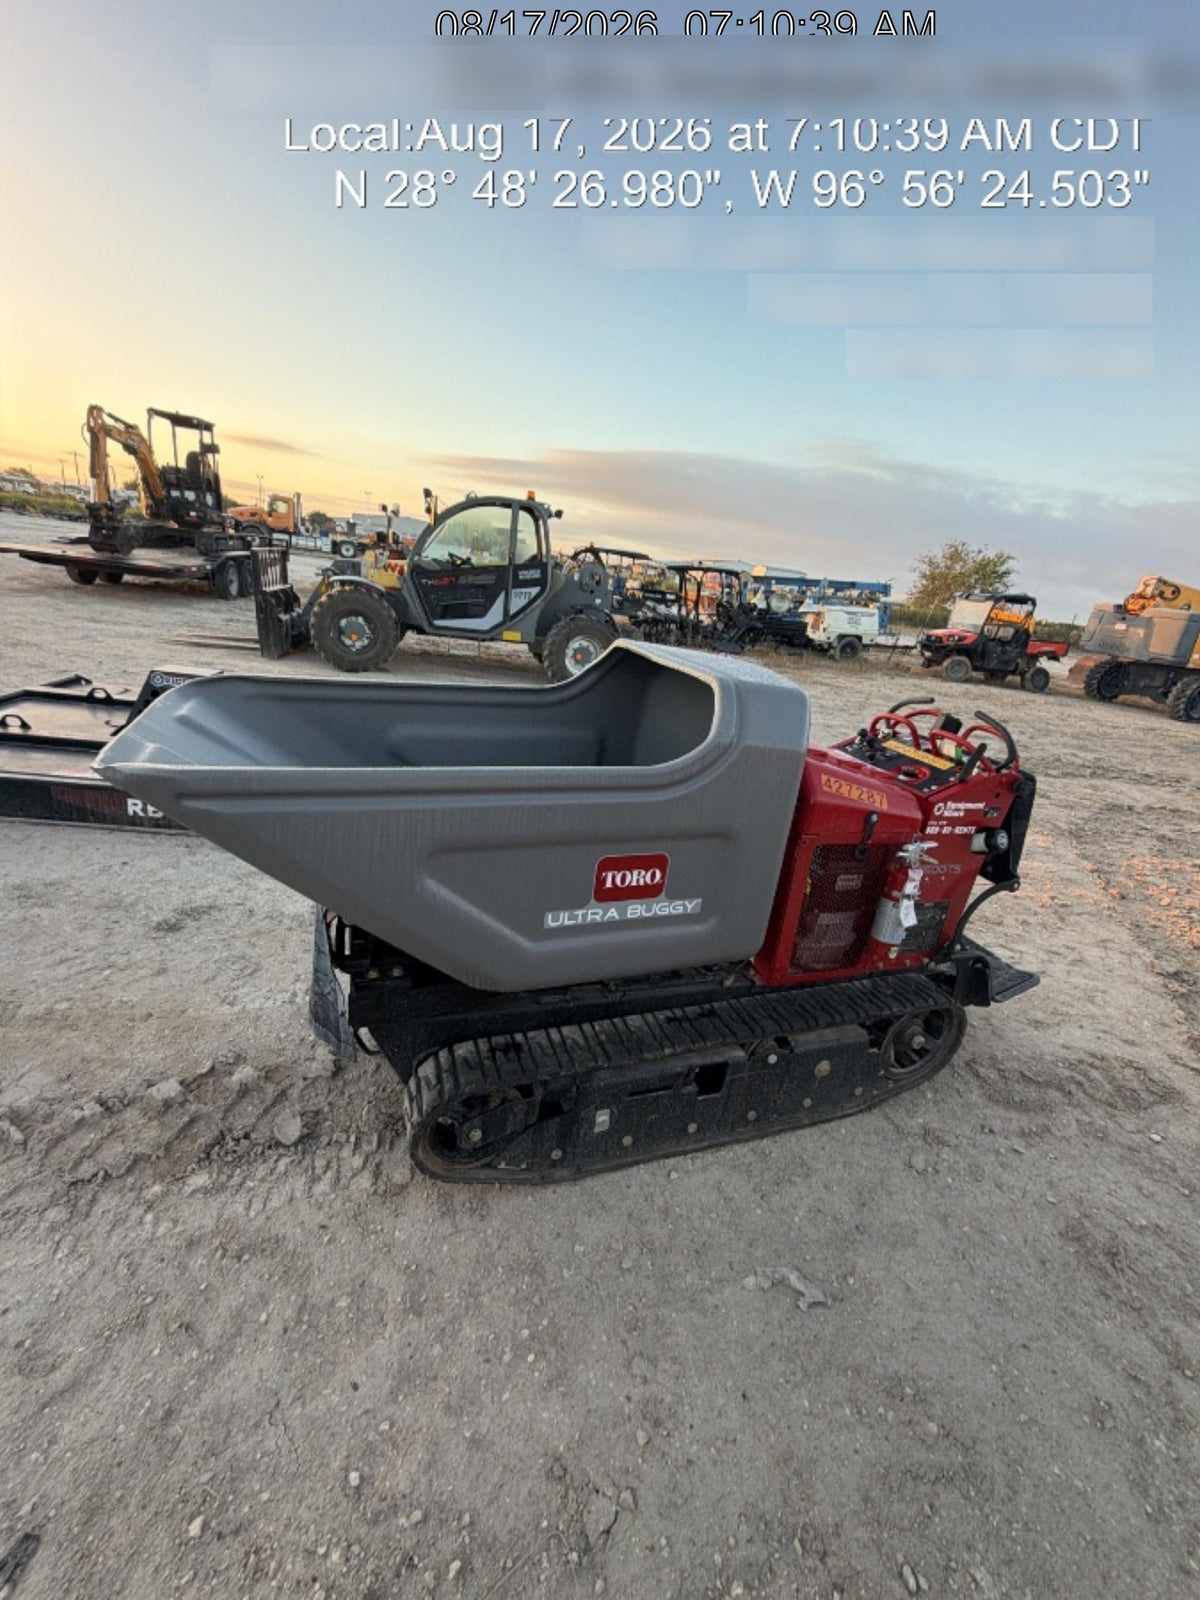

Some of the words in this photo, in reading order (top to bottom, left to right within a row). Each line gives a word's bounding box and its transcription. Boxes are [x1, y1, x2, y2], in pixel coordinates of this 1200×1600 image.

[602, 868, 662, 889] TORO
[548, 908, 619, 927] ULTRA
[626, 900, 698, 918] BUGGY
